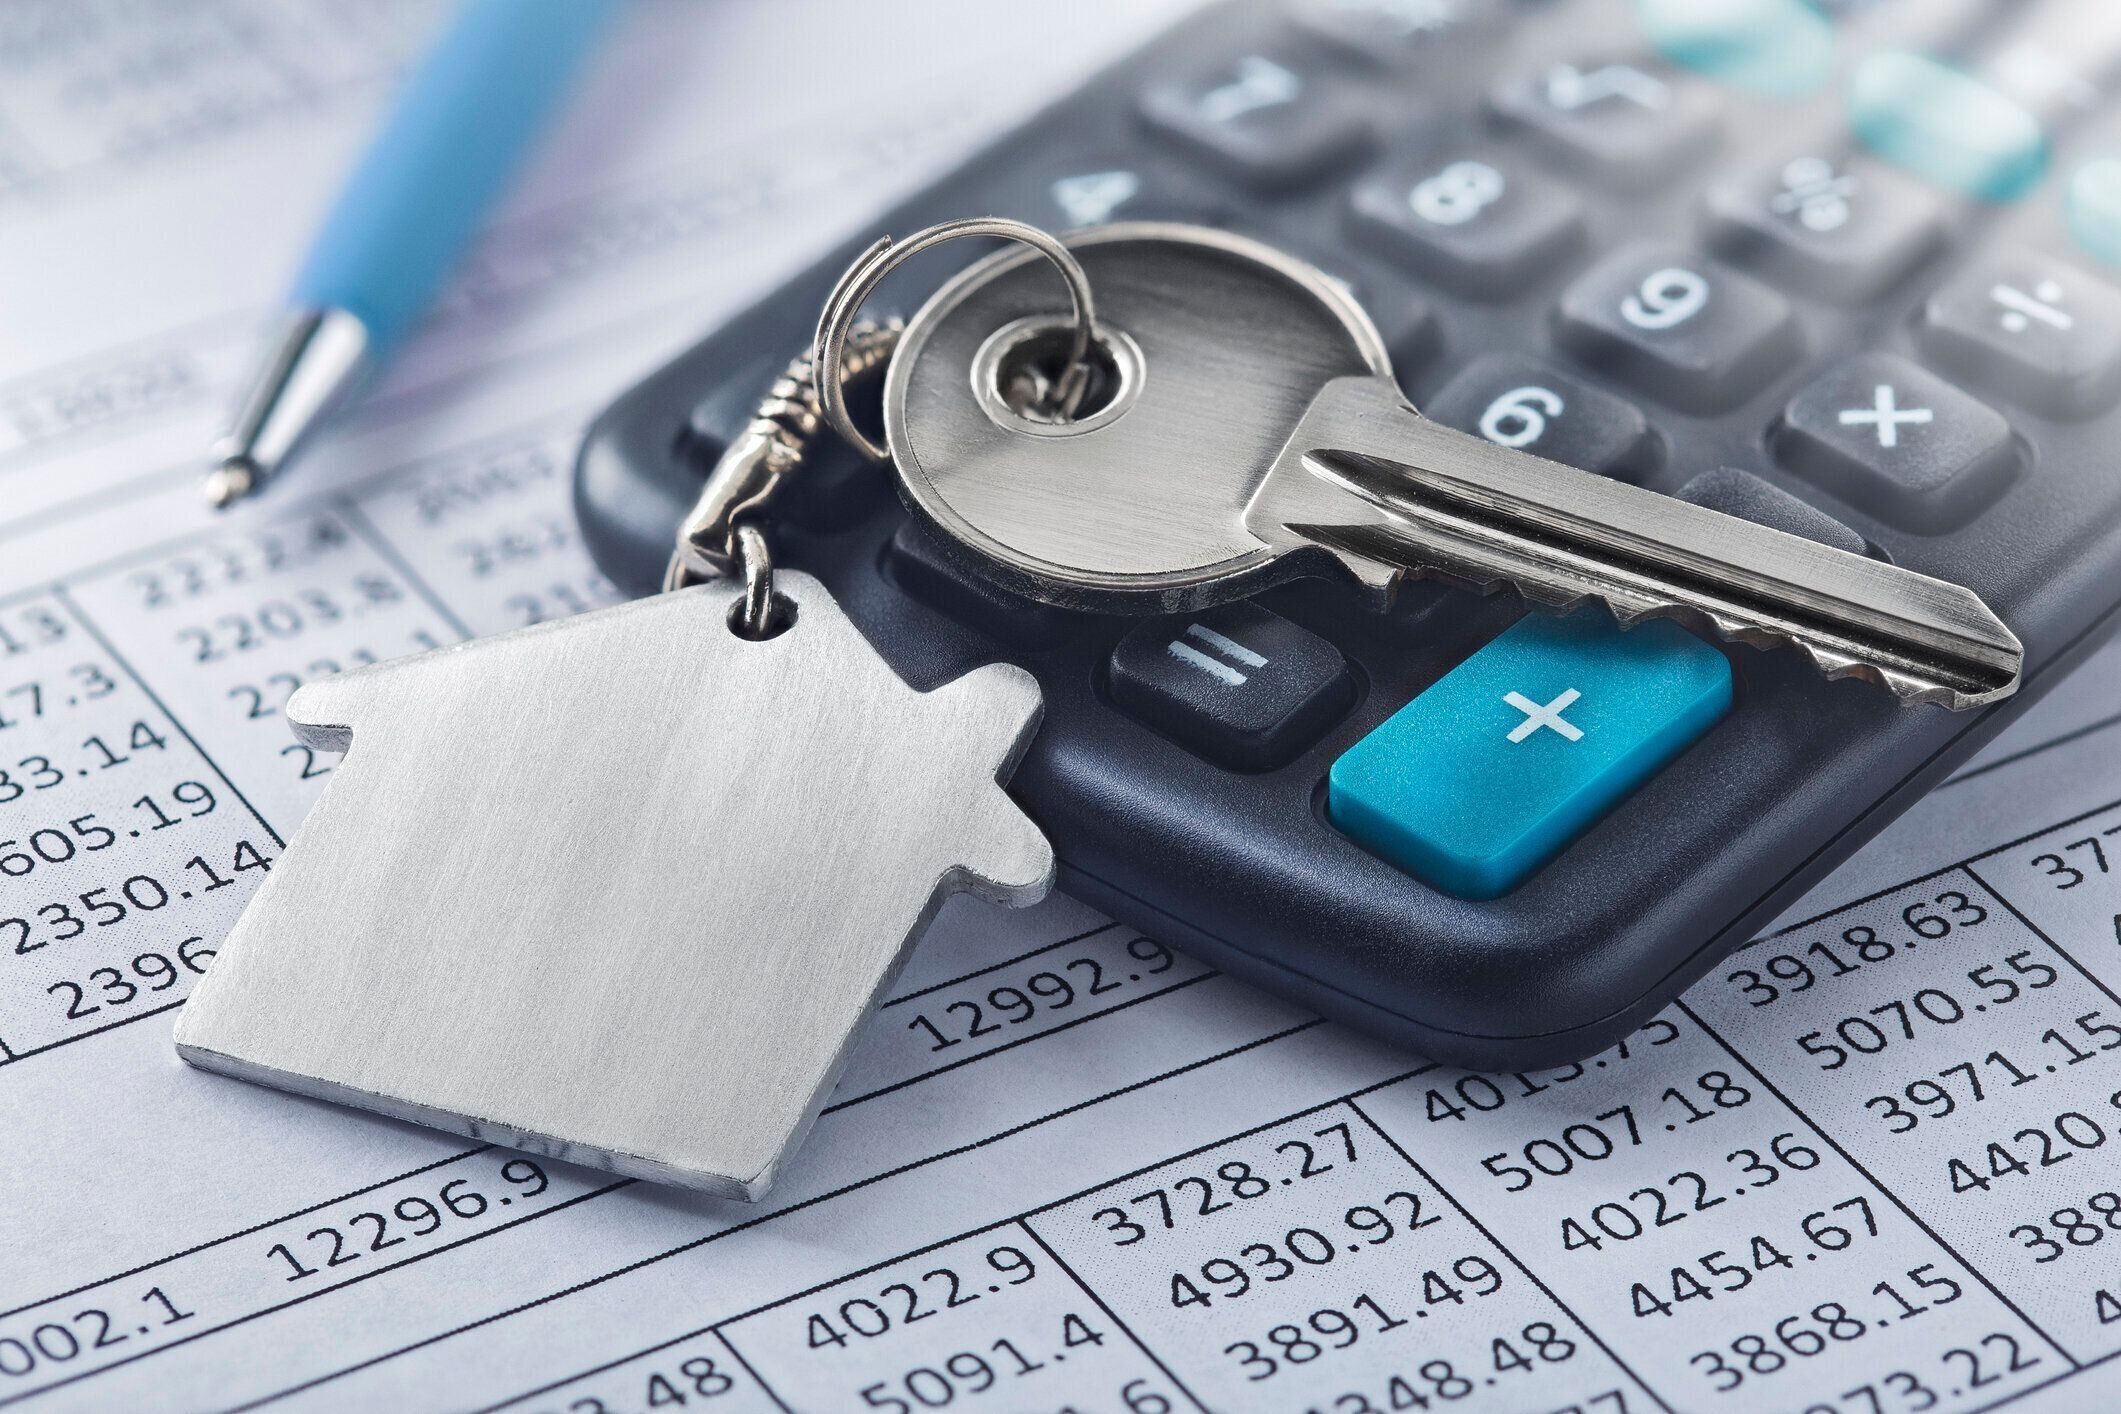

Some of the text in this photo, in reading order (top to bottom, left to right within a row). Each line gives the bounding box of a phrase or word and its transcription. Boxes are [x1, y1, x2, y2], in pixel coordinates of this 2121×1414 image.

[1409, 161, 1504, 225] 8
[1621, 268, 1710, 330] 9
[1479, 386, 1565, 448] 6
[0, 840, 273, 954] 2350.14
[1727, 890, 1988, 1007] 3918.63
[908, 936, 1174, 1052] 12992.9
[1797, 950, 2058, 1070] 5070.55
[1481, 1070, 1752, 1192] 5007.18
[1865, 1011, 2121, 1134] 3971.15
[266, 1158, 549, 1283] 12296.9
[1091, 1122, 1358, 1246] 3728.27
[1560, 1132, 1821, 1252] 4022.36
[806, 1245, 1036, 1351] 4022.9
[1170, 1191, 1443, 1309] 4930.92
[1630, 1196, 1879, 1318] 4454.67
[860, 1312, 1104, 1414] 5091.4
[1224, 1255, 1503, 1382] 3891.49
[1690, 1263, 1963, 1392] 3868.15
